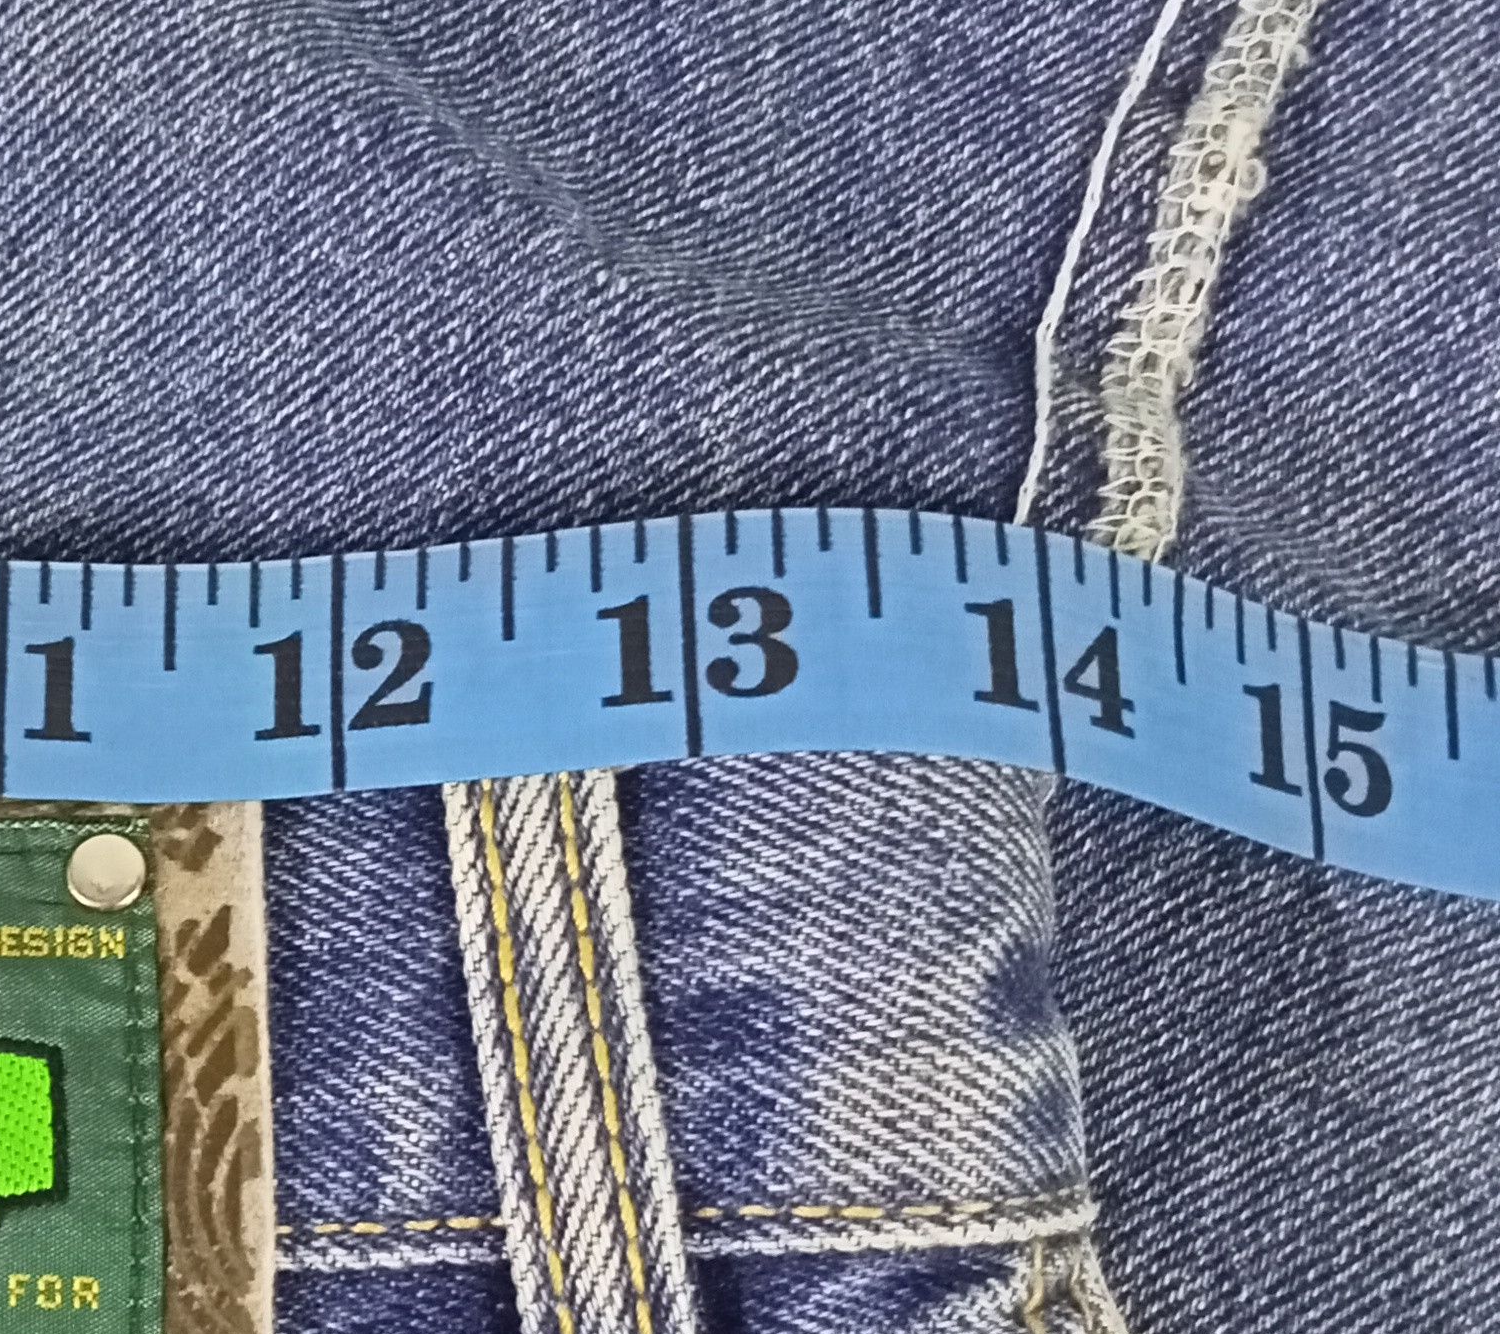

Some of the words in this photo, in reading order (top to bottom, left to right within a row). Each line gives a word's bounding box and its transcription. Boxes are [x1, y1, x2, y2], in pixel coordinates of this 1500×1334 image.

[253, 618, 434, 741] 12
[596, 586, 799, 708] 13
[964, 598, 1137, 739] 14
[1242, 683, 1395, 818] 15
[7, 1273, 100, 1310] FOR
